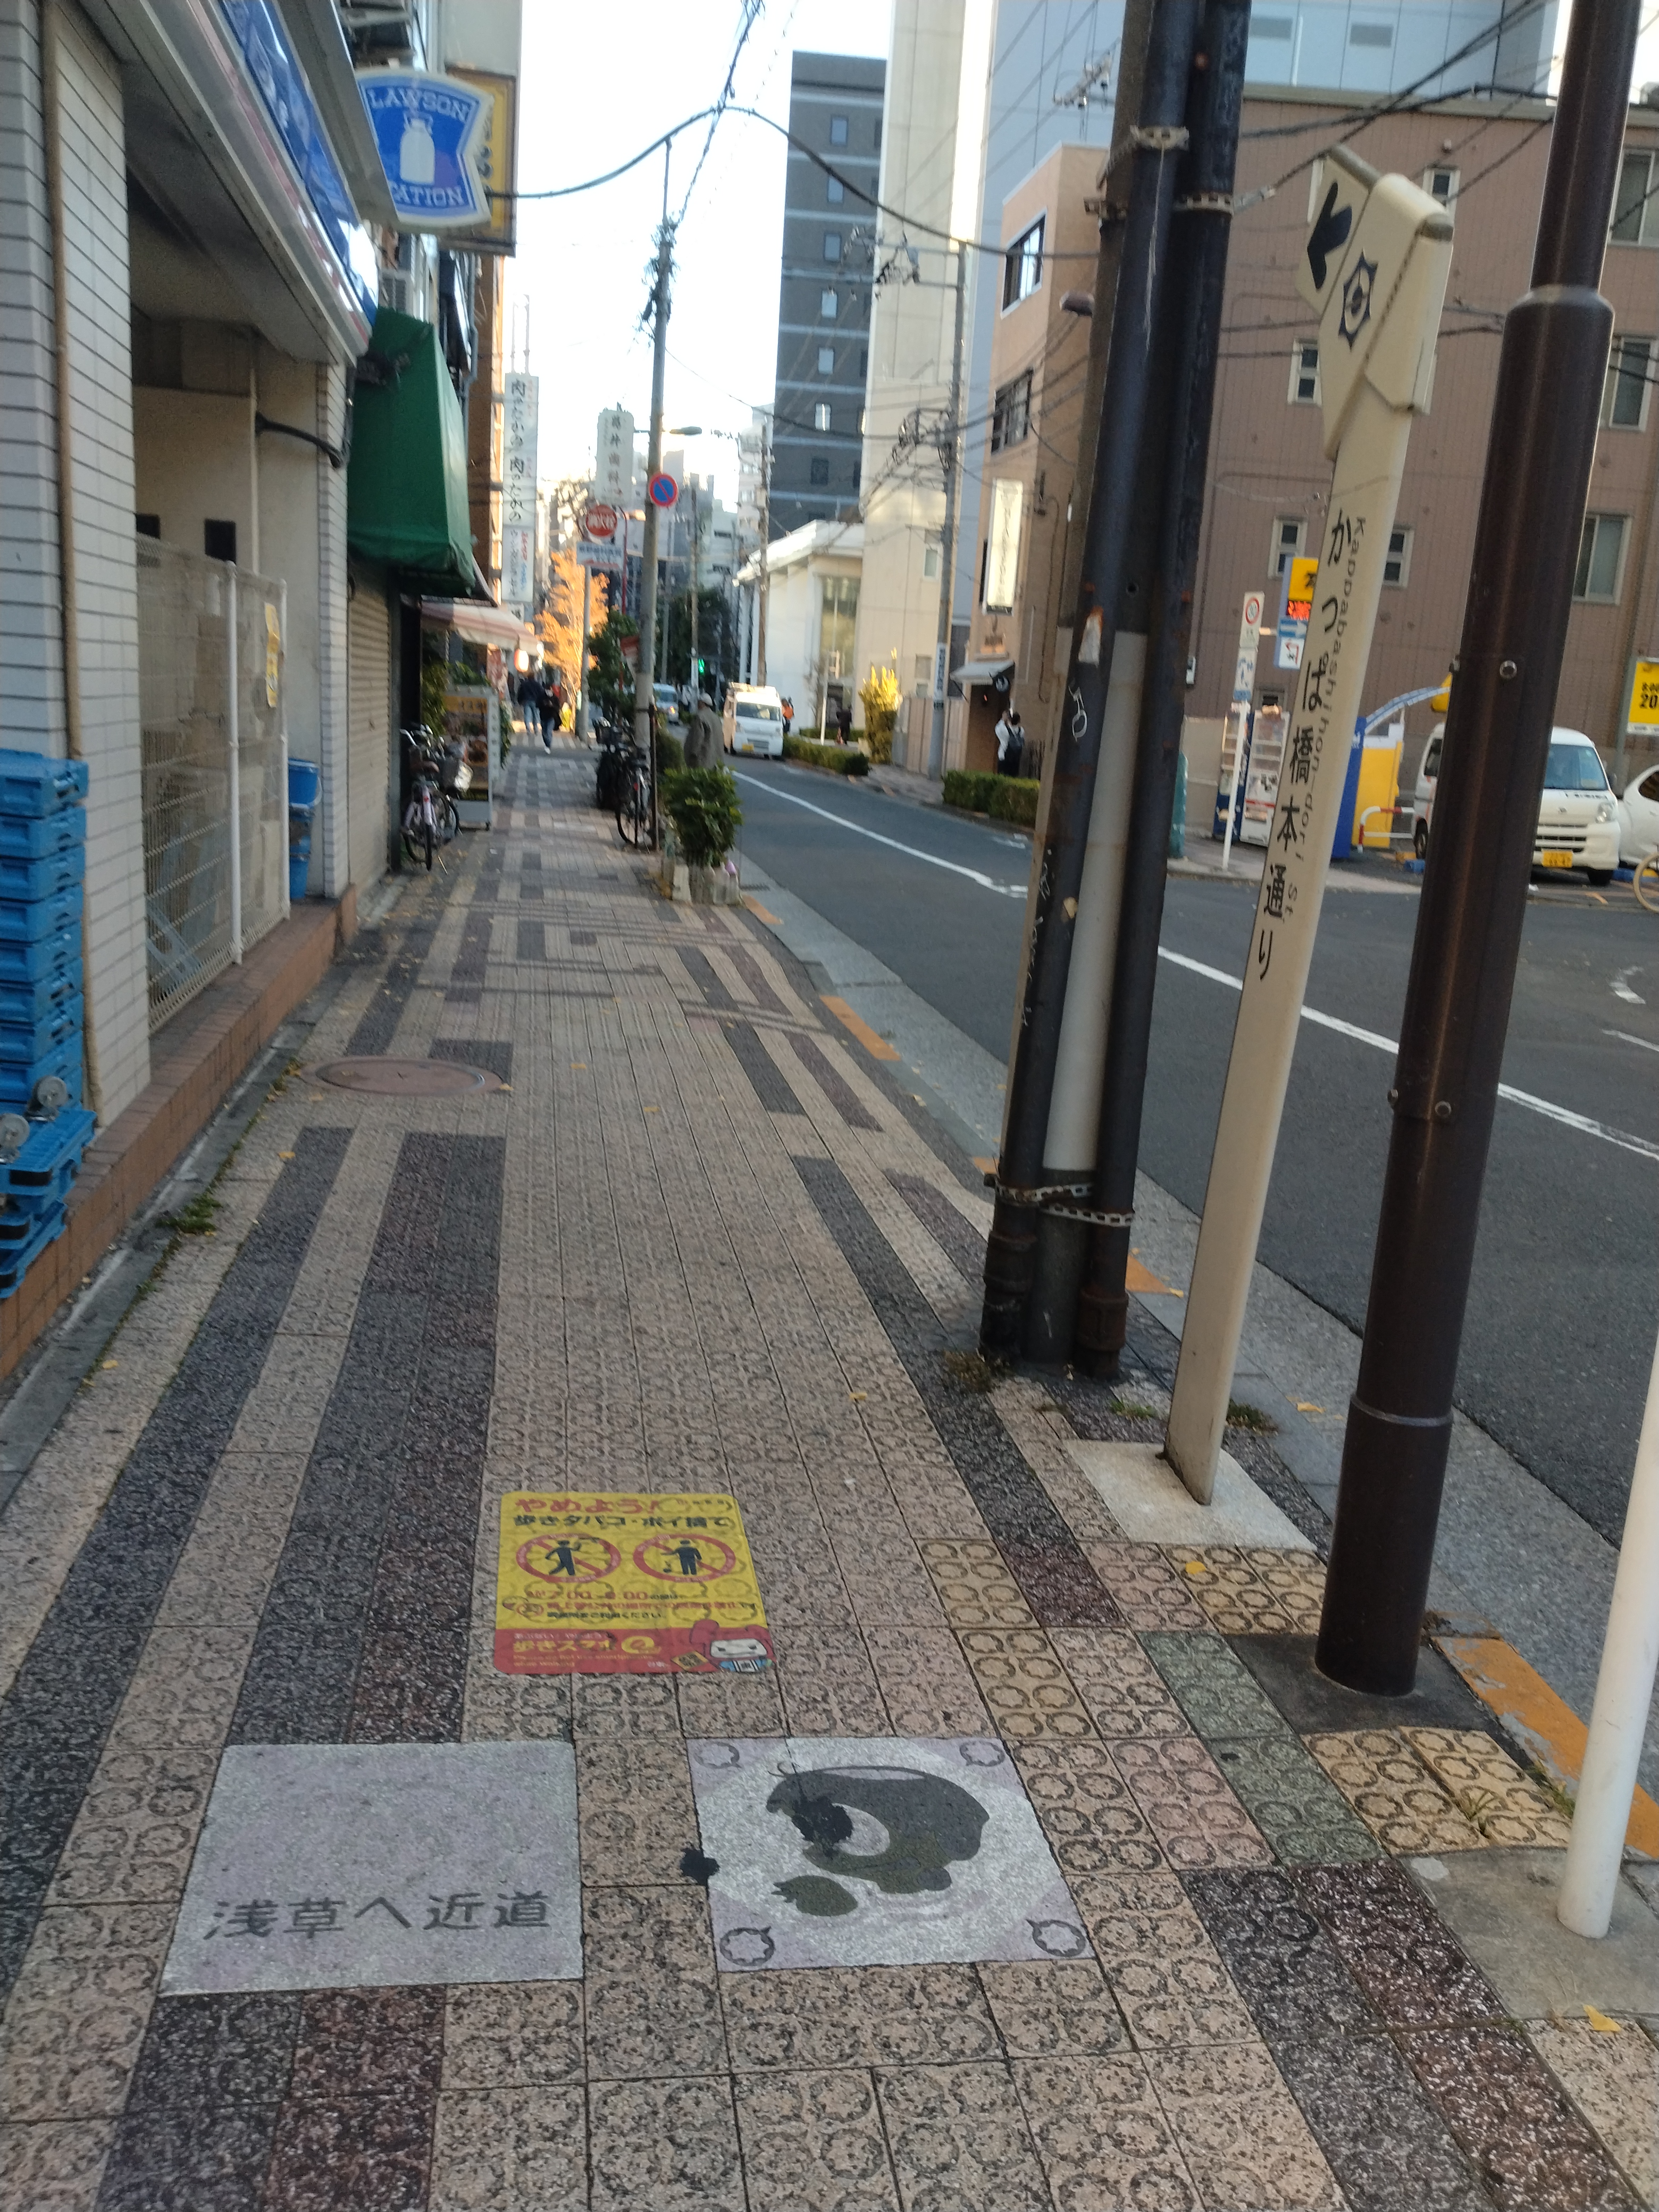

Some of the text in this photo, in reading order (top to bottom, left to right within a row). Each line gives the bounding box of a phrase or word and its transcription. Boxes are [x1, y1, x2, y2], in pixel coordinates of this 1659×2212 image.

[367, 88, 471, 123] LAWSON
[1259, 508, 1352, 981] かっぱ橋本通り
[203, 1889, 551, 1940] 浅草へ近道
